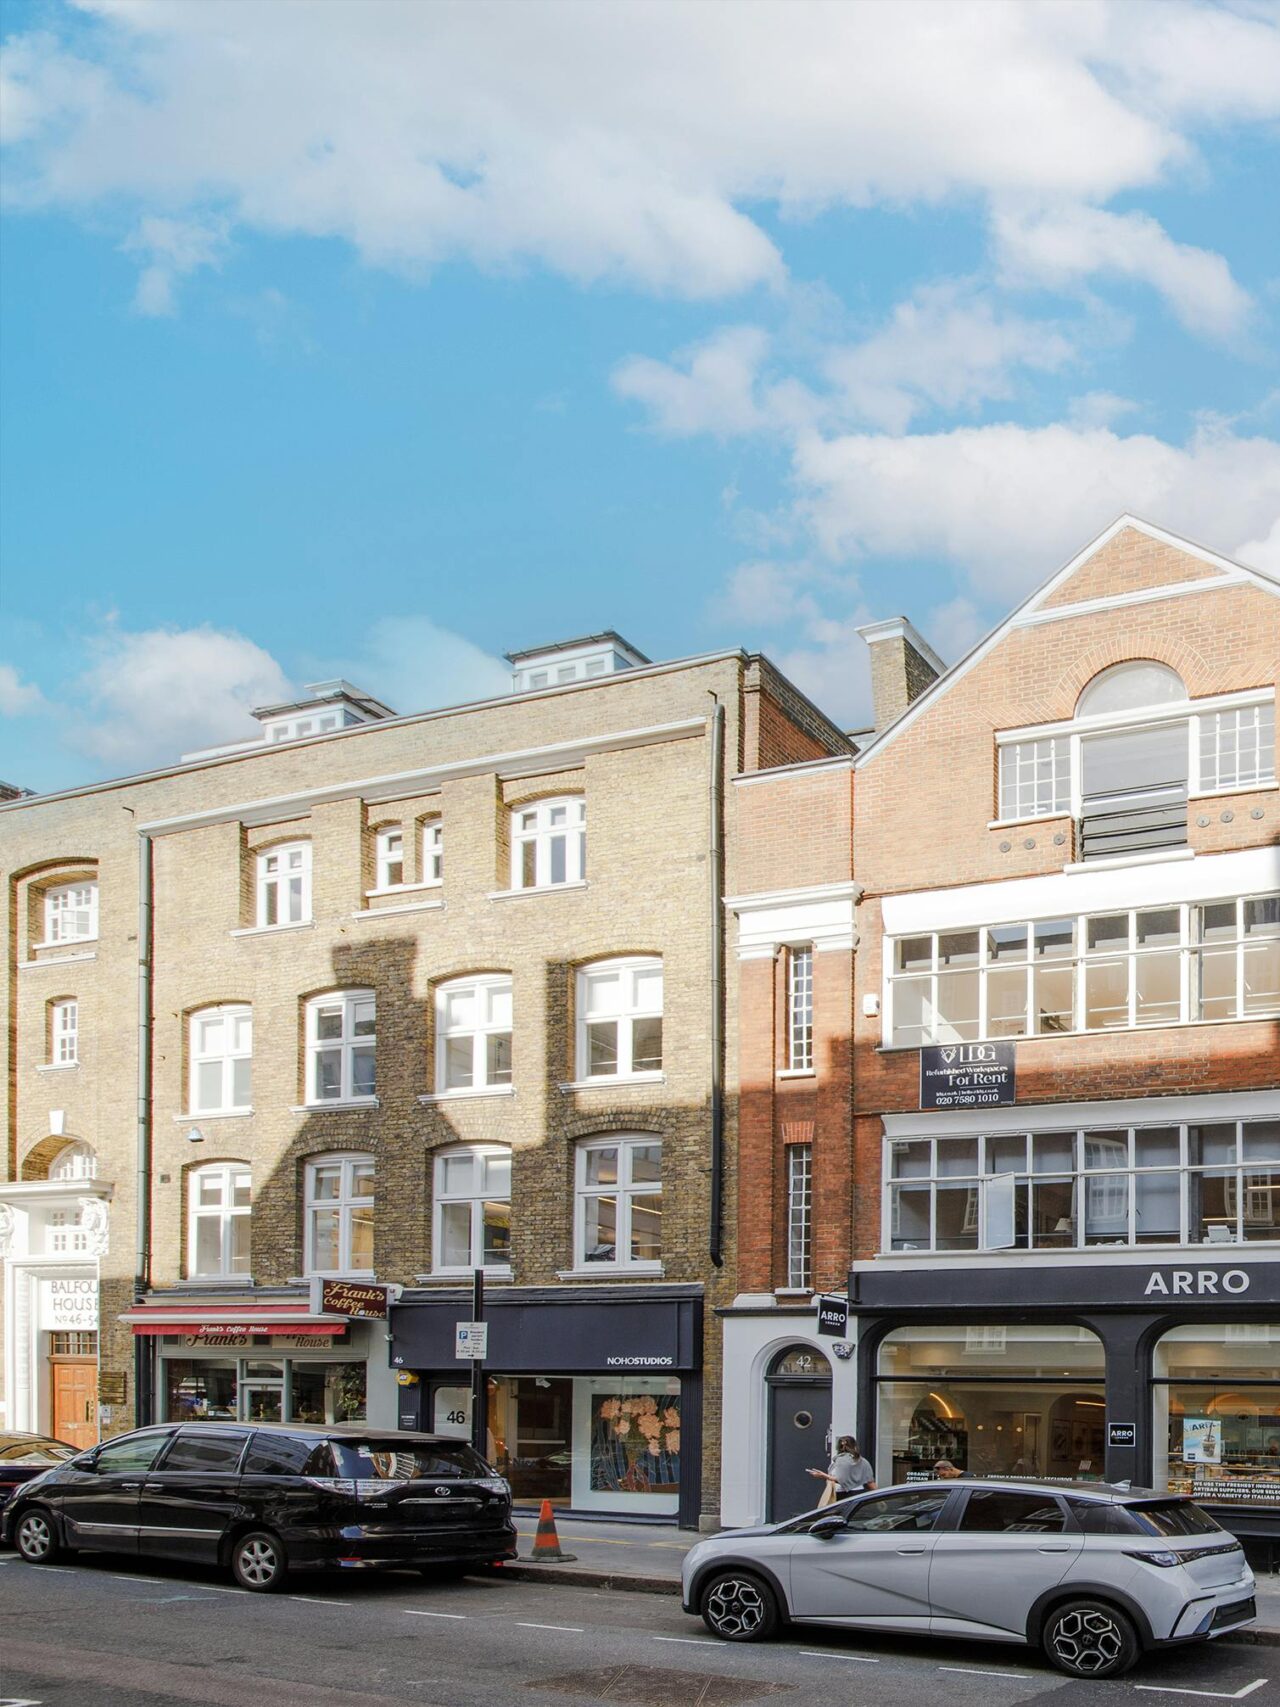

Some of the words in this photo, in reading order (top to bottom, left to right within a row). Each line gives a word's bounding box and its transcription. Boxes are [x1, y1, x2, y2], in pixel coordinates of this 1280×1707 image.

[960, 1044, 996, 1062] LDG
[926, 1067, 965, 1076] Refurbished
[966, 1066, 1008, 1074] Workspaces
[949, 1075, 970, 1086] For
[973, 1072, 1008, 1084] Rent
[936, 1097, 952, 1105] 020
[953, 1095, 976, 1103] 7580
[977, 1093, 999, 1102] 1010
[1144, 1269, 1250, 1294] ARRO
[324, 1282, 385, 1301] Frank's
[324, 1296, 365, 1308] Coffee
[349, 1305, 386, 1318] House
[820, 1311, 846, 1322] ARRO
[199, 1325, 224, 1333] Frank's
[226, 1326, 247, 1334] Coffee
[295, 1337, 330, 1347] House
[796, 1356, 811, 1367] 42
[447, 1410, 465, 1424] 46
